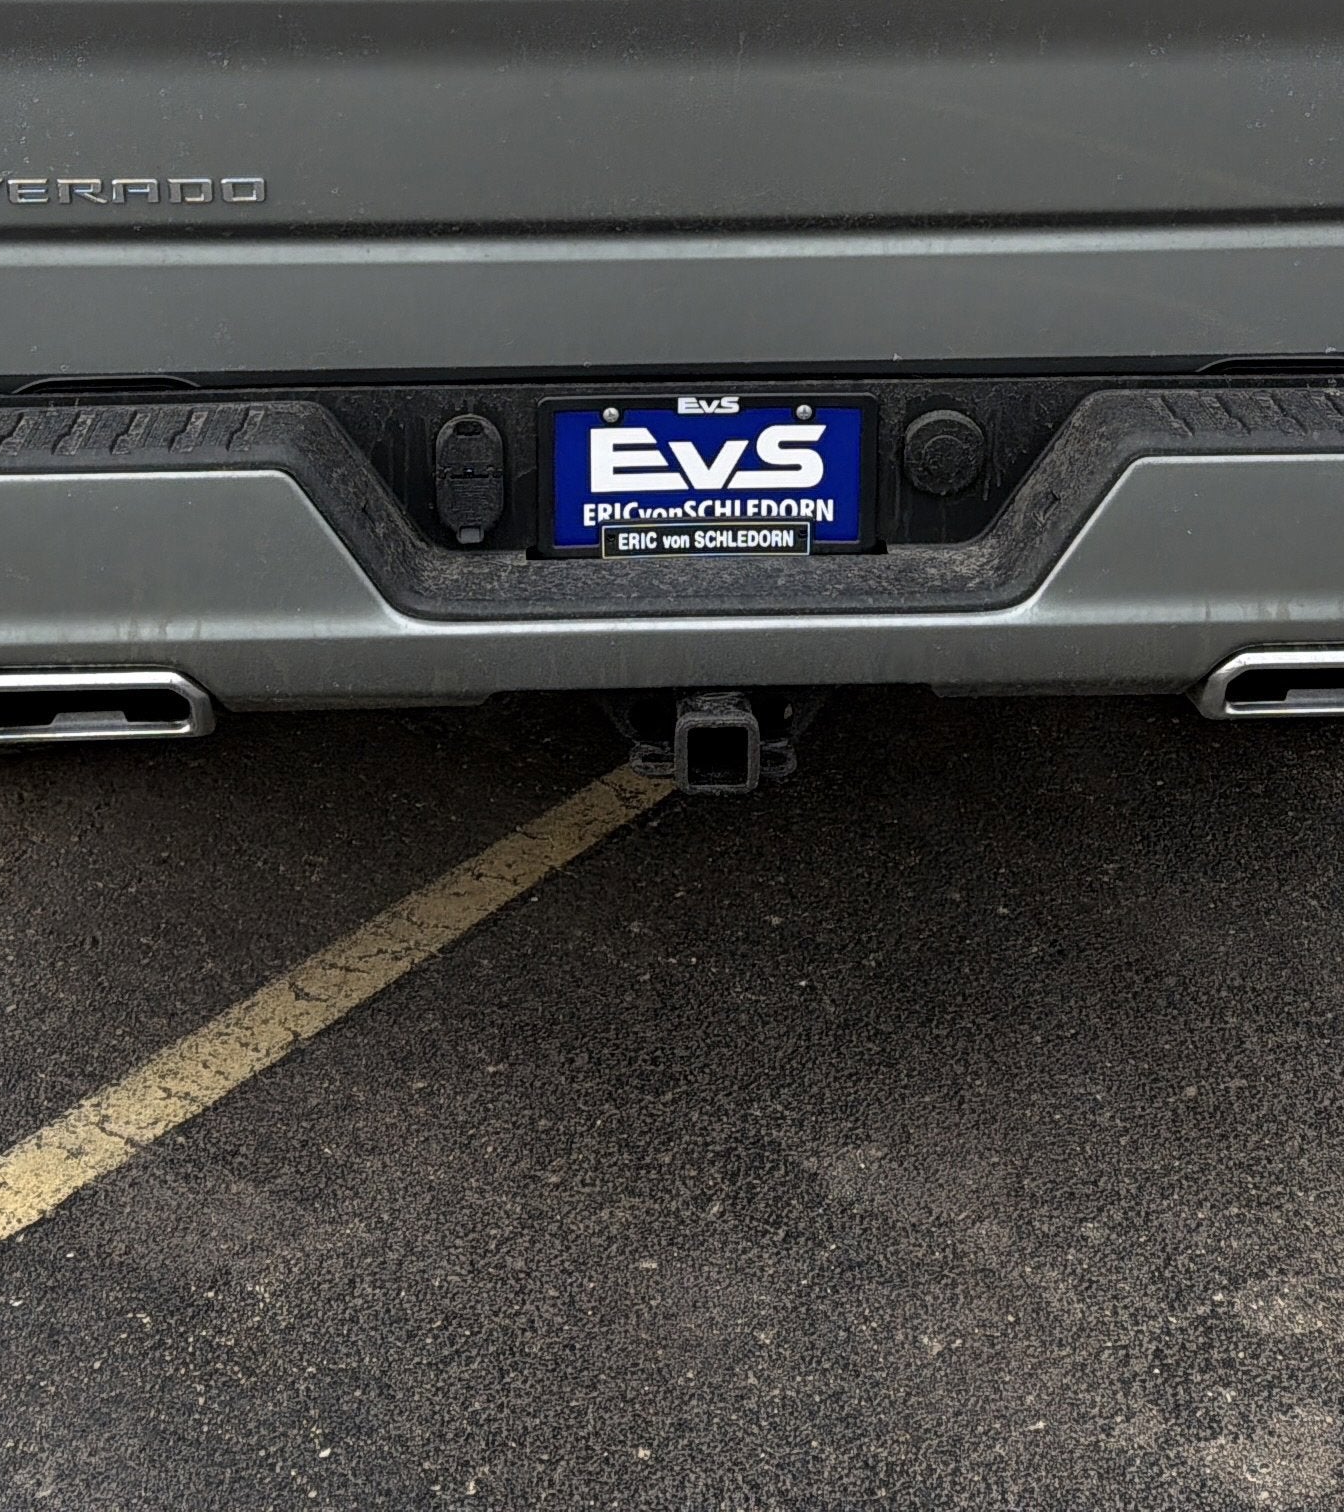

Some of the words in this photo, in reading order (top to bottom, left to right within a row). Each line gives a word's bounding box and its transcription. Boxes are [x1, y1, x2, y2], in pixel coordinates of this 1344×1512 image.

[677, 396, 740, 414] EvS
[590, 424, 827, 492] EvS
[618, 532, 657, 551] ERIC
[663, 534, 690, 549] von
[694, 529, 794, 548] SCHLEDORN
